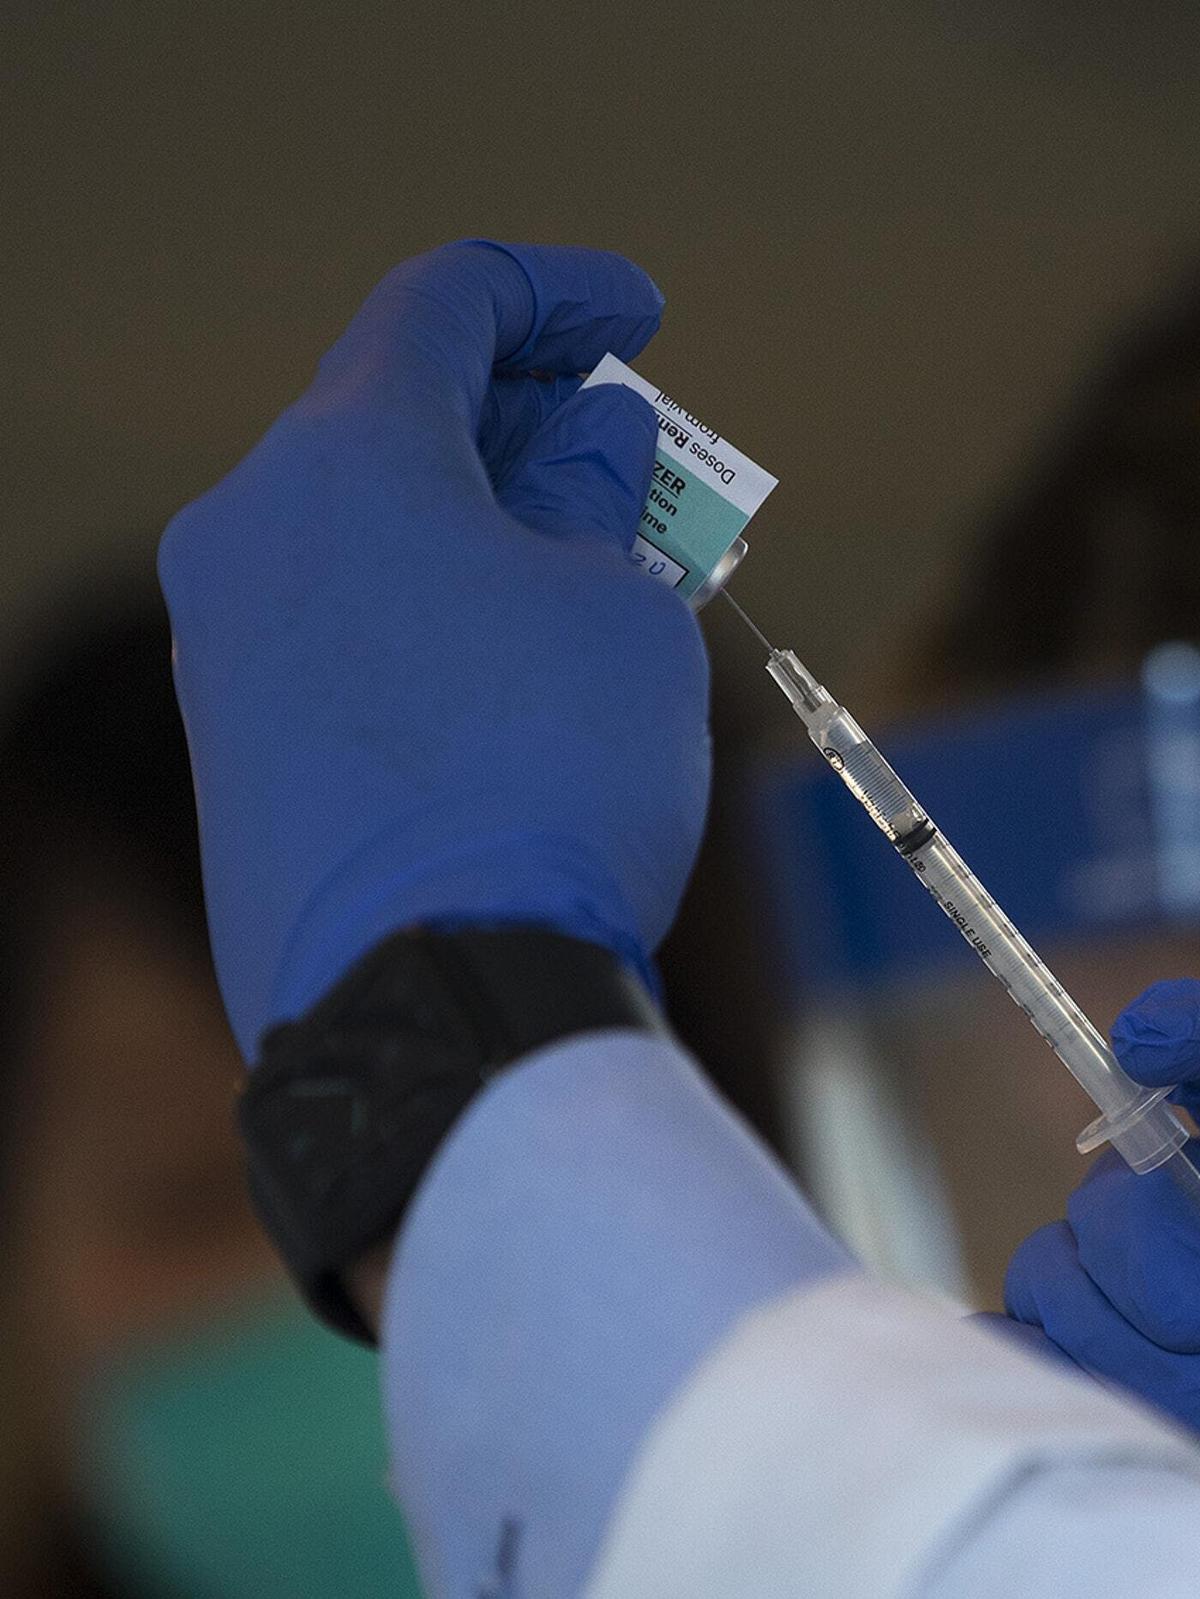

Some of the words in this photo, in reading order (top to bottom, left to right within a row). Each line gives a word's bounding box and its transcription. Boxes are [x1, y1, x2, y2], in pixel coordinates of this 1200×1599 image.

[652, 460, 686, 495] ZER
[689, 442, 736, 485] Doses
[640, 506, 668, 534] ime
[649, 489, 678, 517] tion
[943, 901, 975, 937] SINGLE
[972, 937, 992, 958] USE
